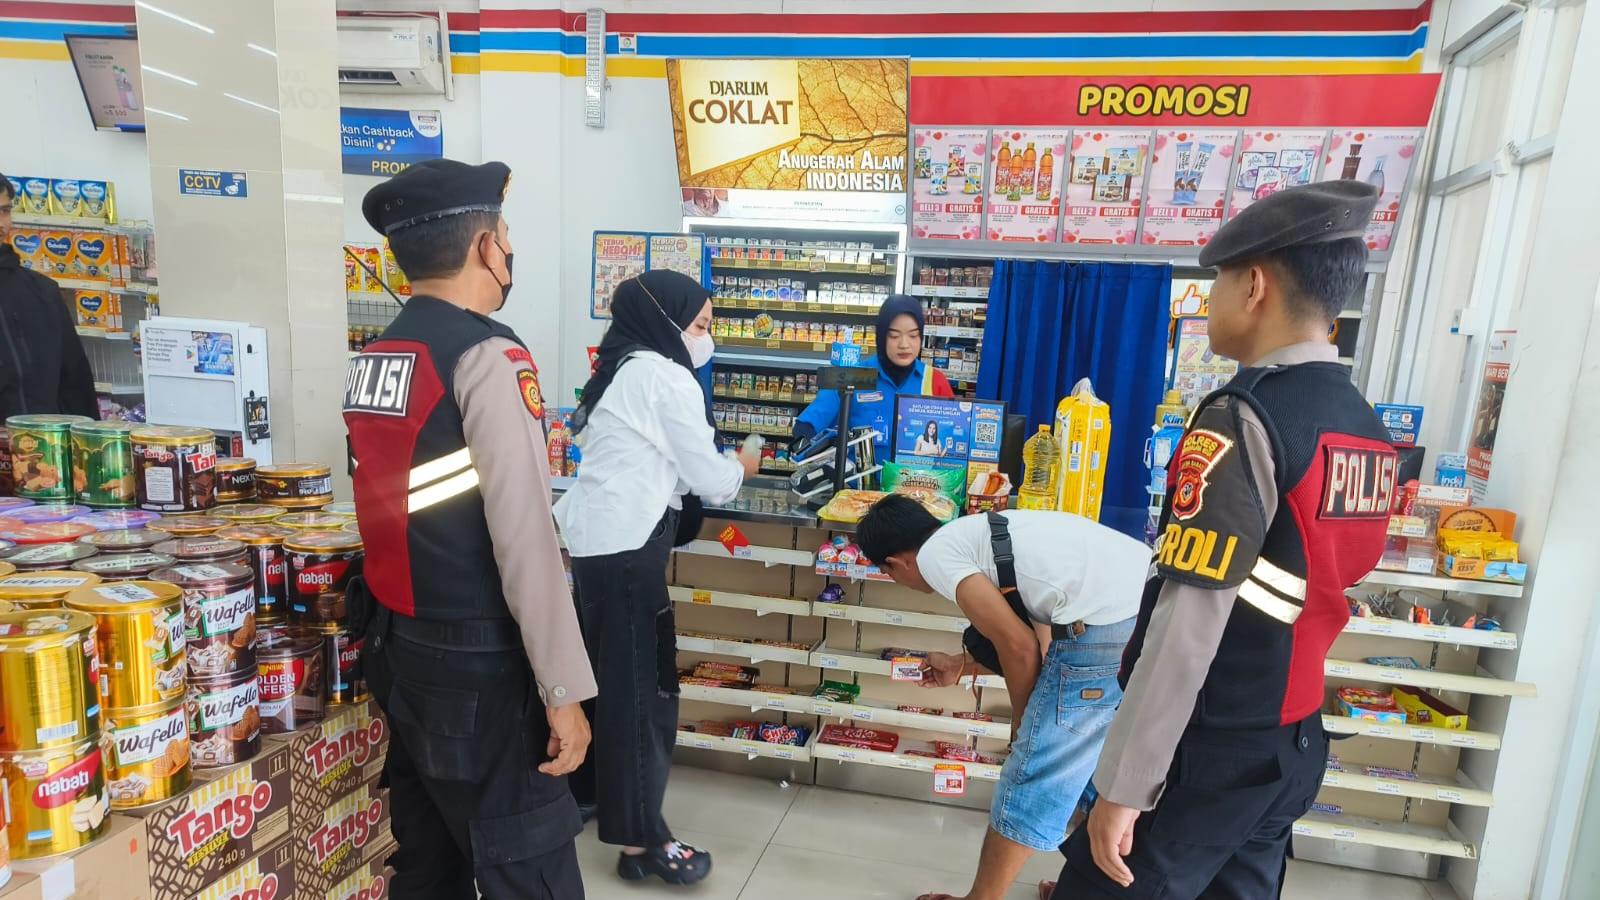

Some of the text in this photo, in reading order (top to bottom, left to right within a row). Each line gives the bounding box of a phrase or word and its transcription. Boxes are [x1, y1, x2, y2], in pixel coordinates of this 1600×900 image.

[709, 80, 769, 98] DJARUM
[1076, 84, 1252, 117] PROMOSI
[688, 99, 794, 125] COKLAT
[362, 125, 415, 138] Cashback
[343, 136, 375, 149] Disini!
[860, 150, 905, 171] ALAM
[184, 176, 221, 189] CCTV
[807, 173, 905, 192] INDONESIA
[920, 203, 934, 212] BELI
[949, 204, 978, 213] GRATIS 1
[994, 205, 1009, 213] BELI
[1072, 207, 1094, 215] BELI 2
[1104, 208, 1136, 216] GRATIS 1
[1152, 208, 1175, 216] BELI 1
[1186, 209, 1219, 217] GRATIS 1
[602, 245, 642, 256] HEBOH!
[344, 359, 410, 409] POLISI
[144, 450, 174, 463] Tango
[1326, 452, 1396, 513] POLISI
[298, 572, 333, 585] nabati
[205, 593, 255, 622] Wafello
[204, 689, 258, 718] Wafello
[119, 718, 184, 754] Wafello
[305, 718, 384, 780] Tango
[39, 770, 90, 798] nabati
[168, 781, 272, 858] Tango
[308, 799, 383, 862] Tango
[218, 850, 238, 872] 240
